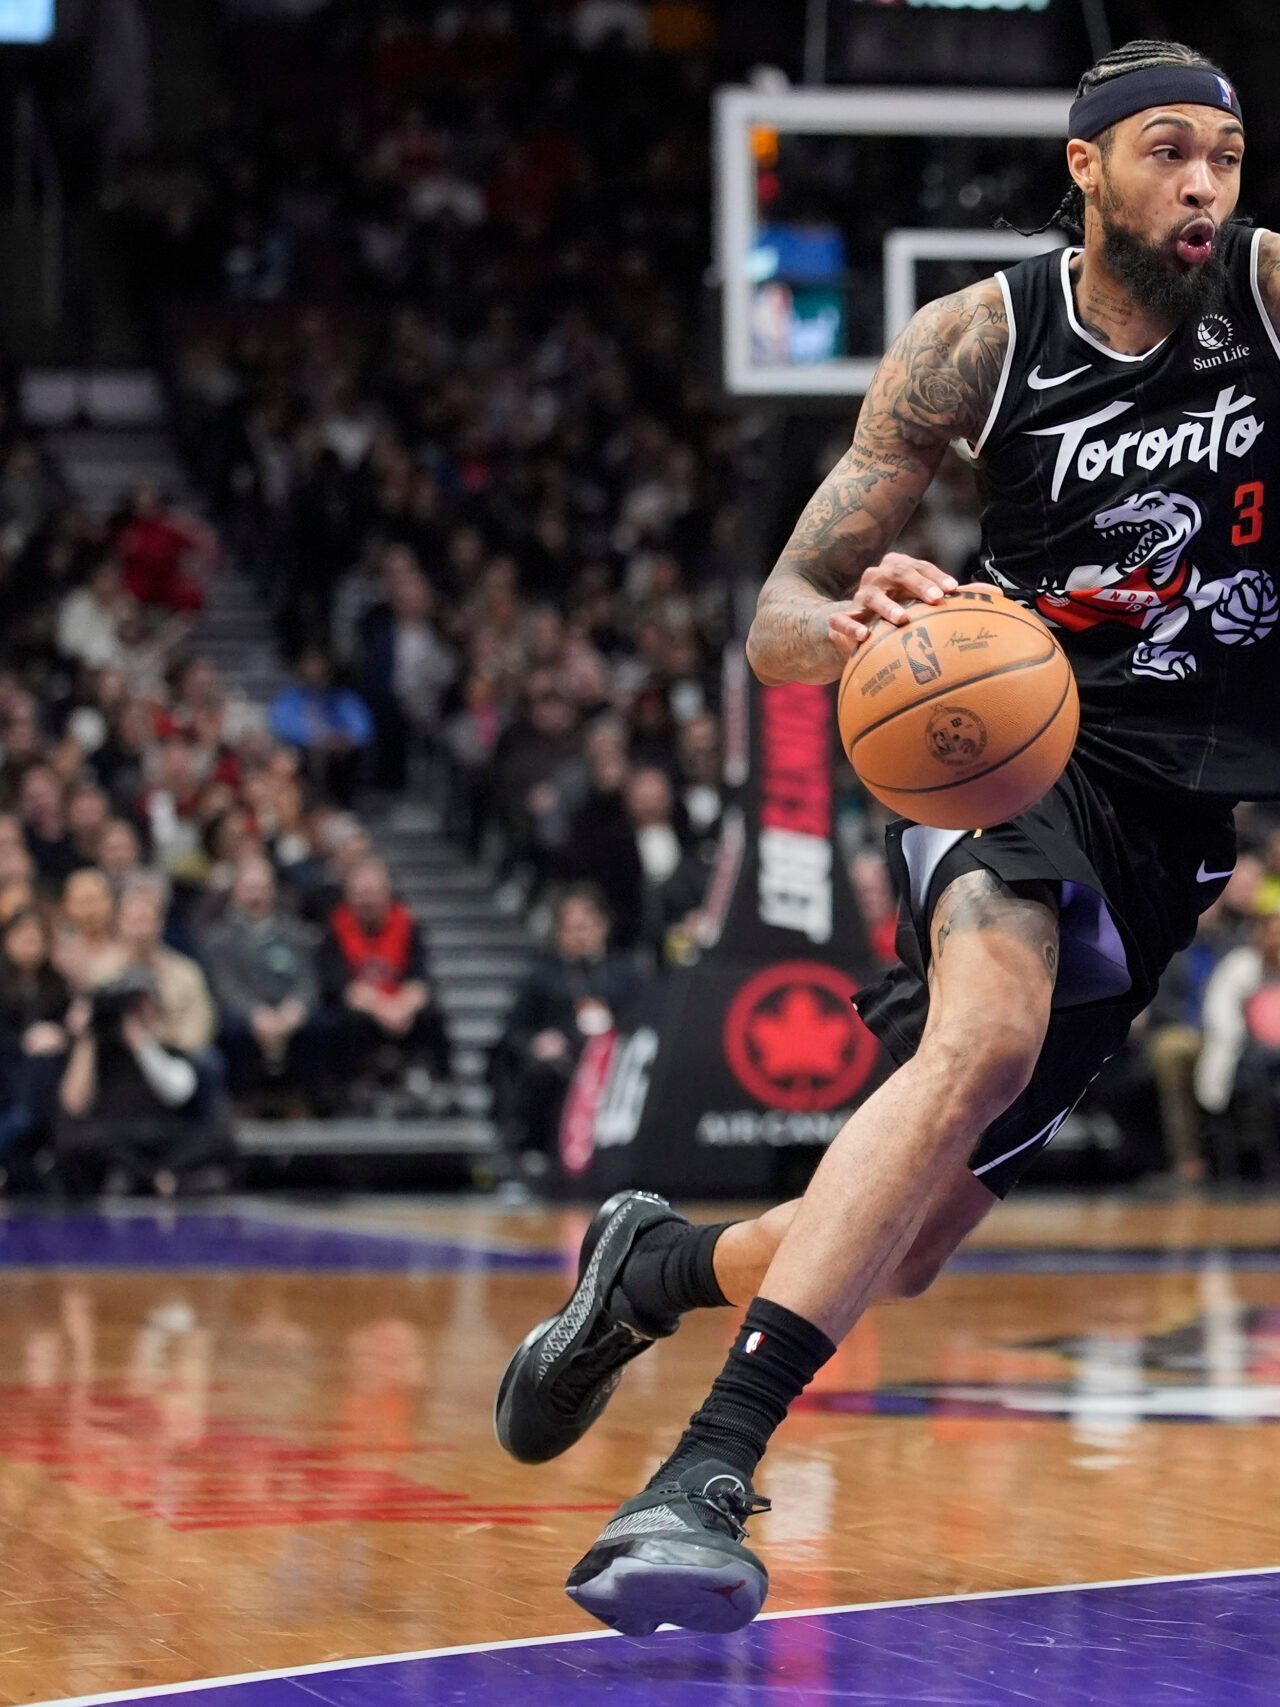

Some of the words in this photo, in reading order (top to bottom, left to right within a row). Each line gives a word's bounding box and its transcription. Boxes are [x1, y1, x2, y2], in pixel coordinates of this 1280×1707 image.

[1193, 357, 1221, 371] Sun
[1223, 344, 1250, 362] Life
[1021, 385, 1264, 502] Toronto
[1232, 481, 1264, 546] 3
[759, 680, 833, 943] OINTSBET
